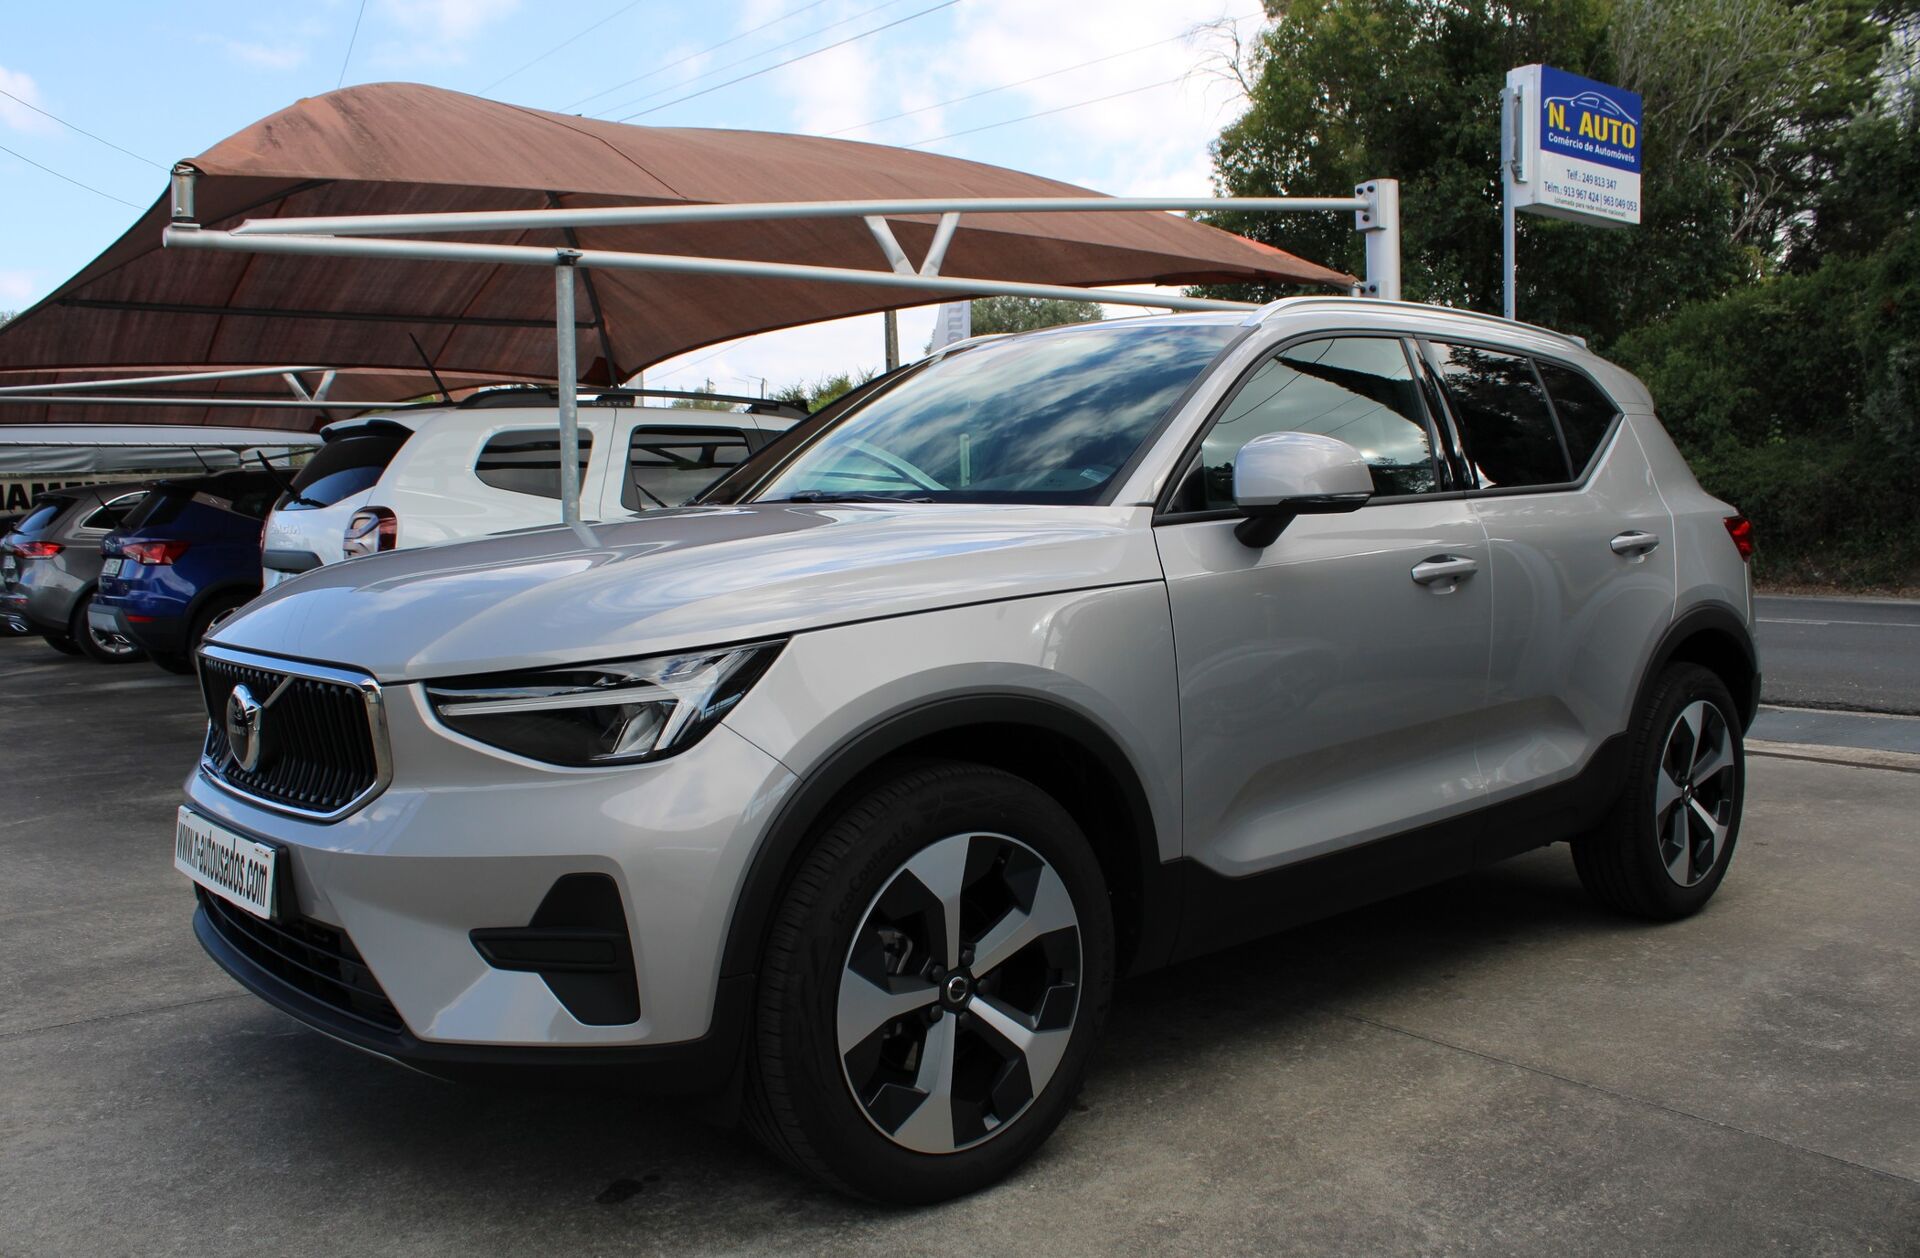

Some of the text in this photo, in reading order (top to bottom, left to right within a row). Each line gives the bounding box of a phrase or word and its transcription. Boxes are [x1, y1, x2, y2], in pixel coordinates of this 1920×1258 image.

[1549, 101, 1636, 149] N. AUTO
[1548, 132, 1636, 163] Comércio de Automóveis
[1563, 185, 1575, 198] 913
[1575, 188, 1587, 200] 967
[1588, 191, 1599, 203] 424
[1603, 195, 1614, 207] 963
[1615, 197, 1626, 209] 049
[1626, 200, 1638, 212] 053
[1582, 173, 1593, 185] 249
[1594, 176, 1605, 187] 813
[1606, 178, 1617, 190] 347
[177, 821, 268, 908] www.n-autousados.com
[831, 831, 901, 925] EcoContact
